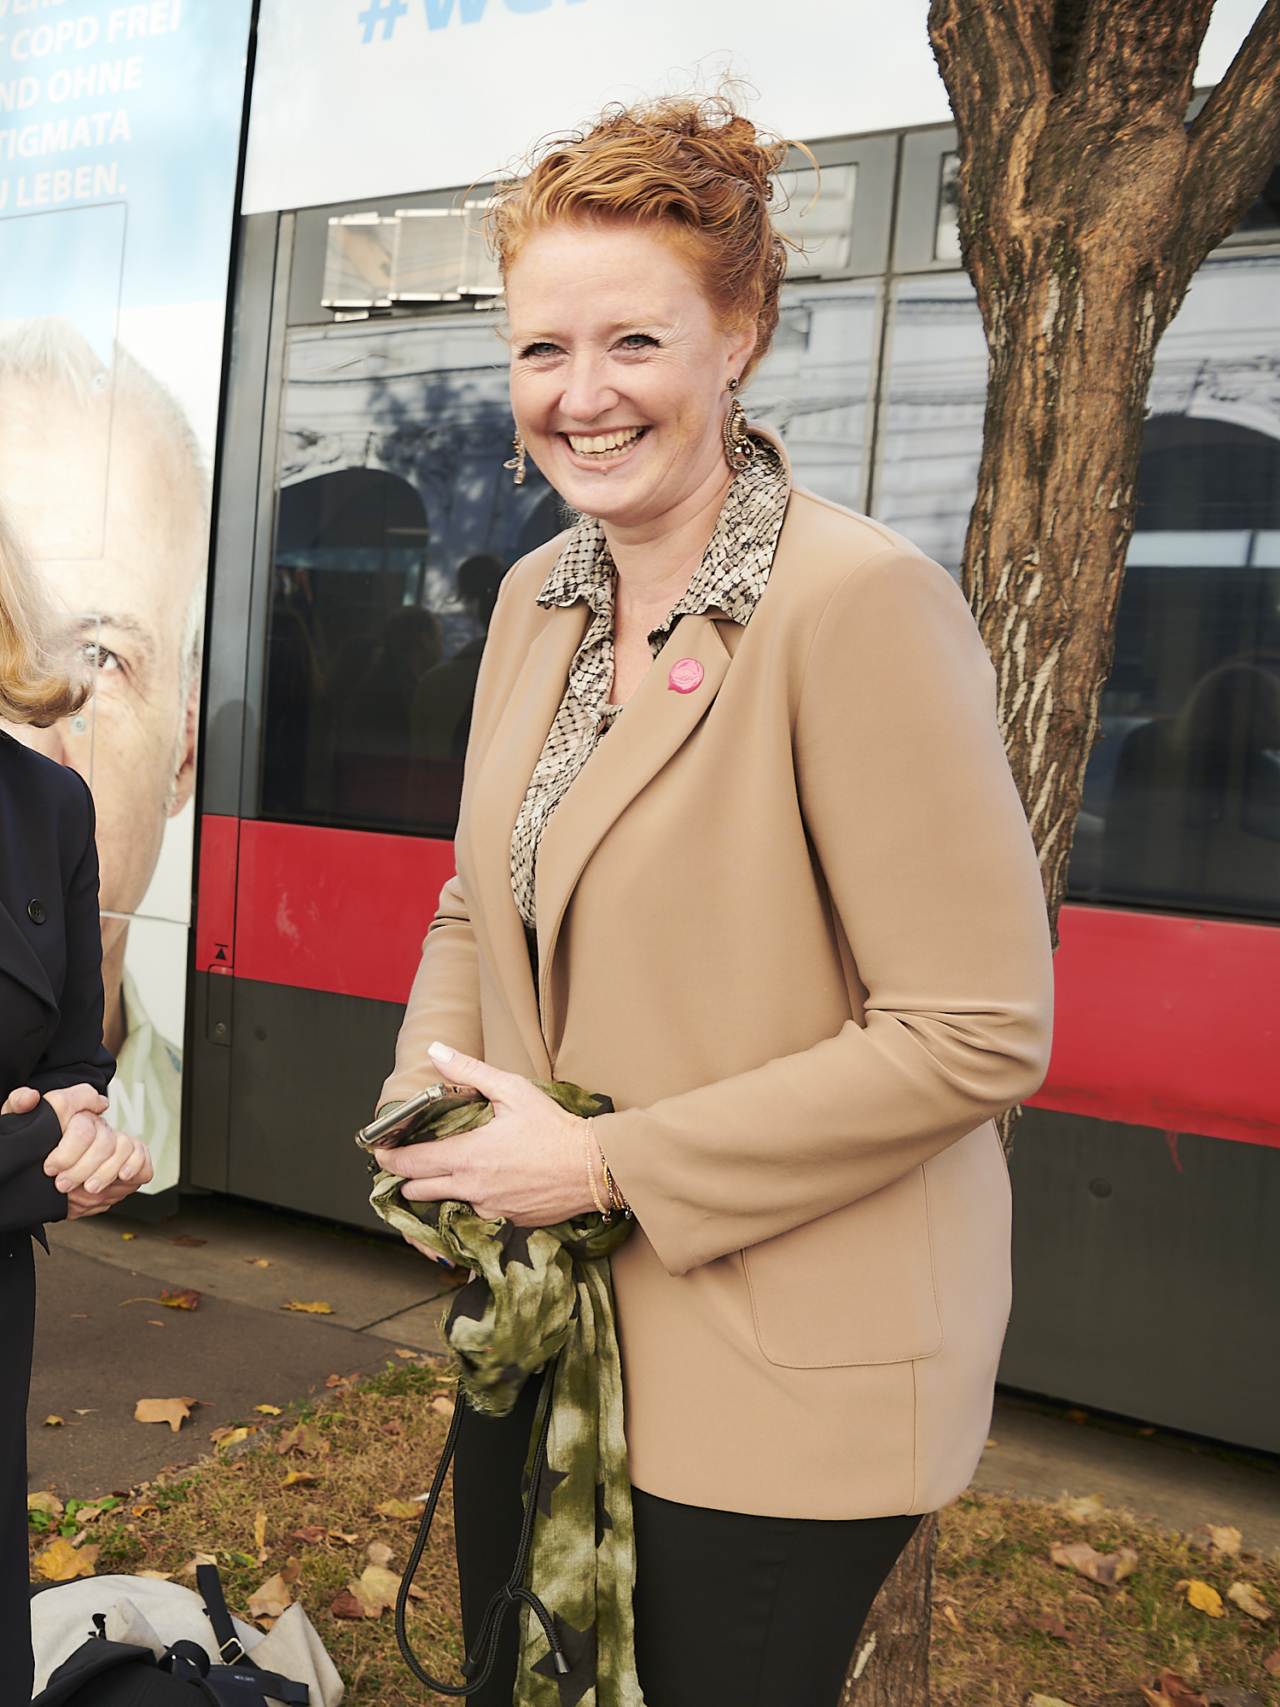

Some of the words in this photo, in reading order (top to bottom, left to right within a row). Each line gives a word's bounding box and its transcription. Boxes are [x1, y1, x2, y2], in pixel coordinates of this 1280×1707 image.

[11, 14, 100, 62] COPD
[107, 0, 182, 44] FREI
[46, 54, 145, 104] OHNE
[16, 162, 128, 209] LEBEN.
